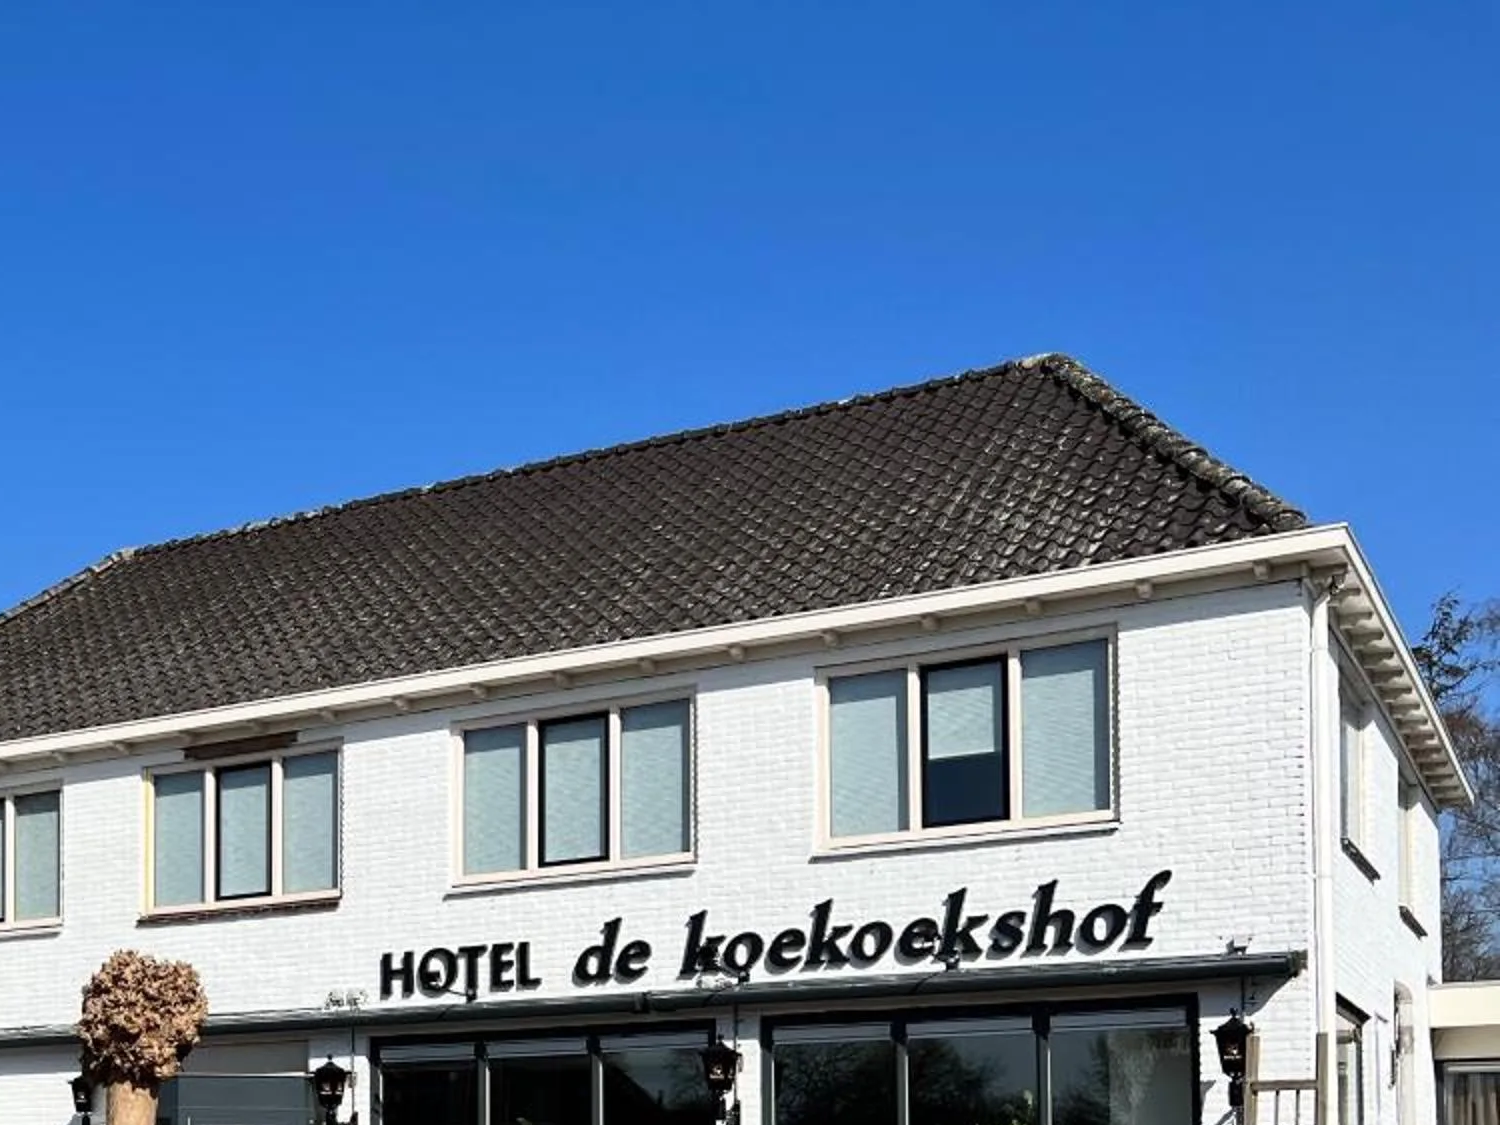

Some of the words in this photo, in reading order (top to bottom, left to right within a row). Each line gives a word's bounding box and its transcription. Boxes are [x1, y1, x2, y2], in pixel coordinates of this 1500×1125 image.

[380, 941, 542, 1001] HOTEL
[572, 917, 652, 986] de
[676, 869, 1173, 980] koekoekshof
